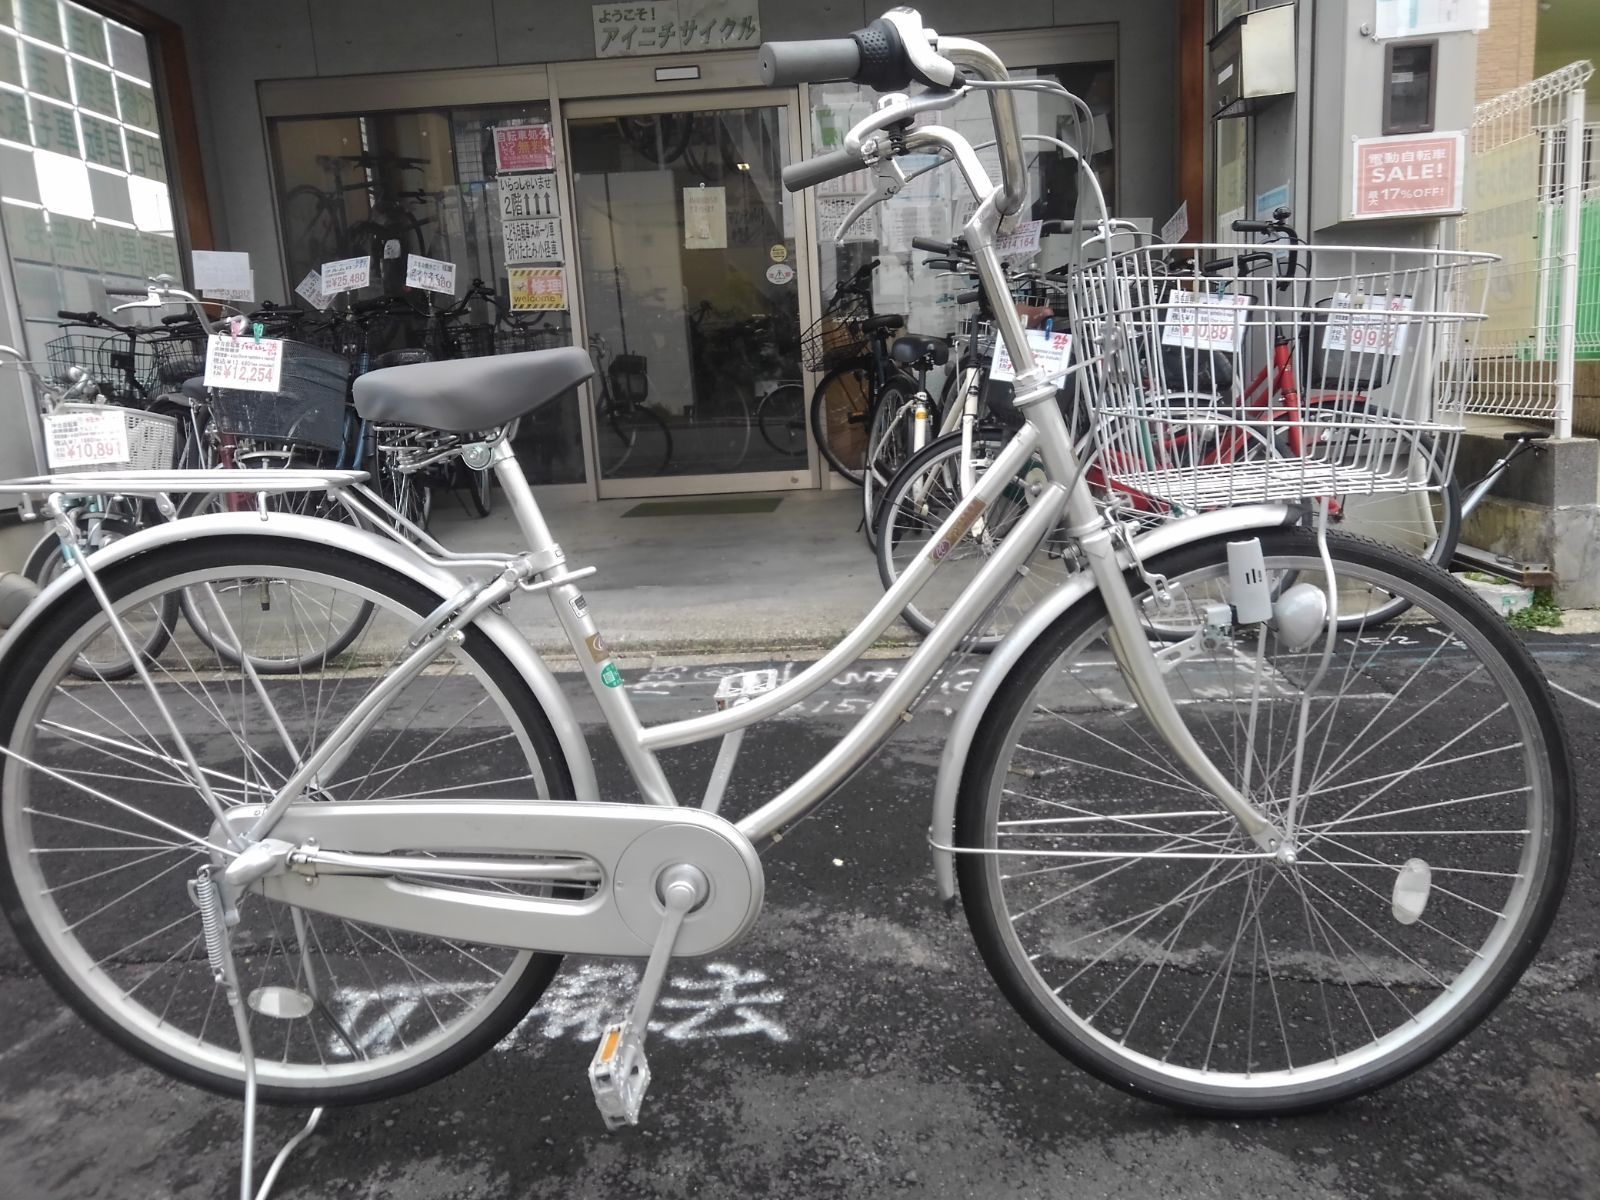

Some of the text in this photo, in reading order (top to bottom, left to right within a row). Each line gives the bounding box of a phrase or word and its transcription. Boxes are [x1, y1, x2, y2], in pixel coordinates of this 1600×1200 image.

[599, 7, 656, 23] ようこそ！
[601, 15, 756, 52] アイニチサイクル
[1367, 149, 1446, 167] 電動自転車
[1371, 163, 1443, 183] SALE!
[500, 176, 552, 191] いらっしゃいませ
[504, 192, 523, 217] 2階
[223, 364, 273, 383] ¥12,254
